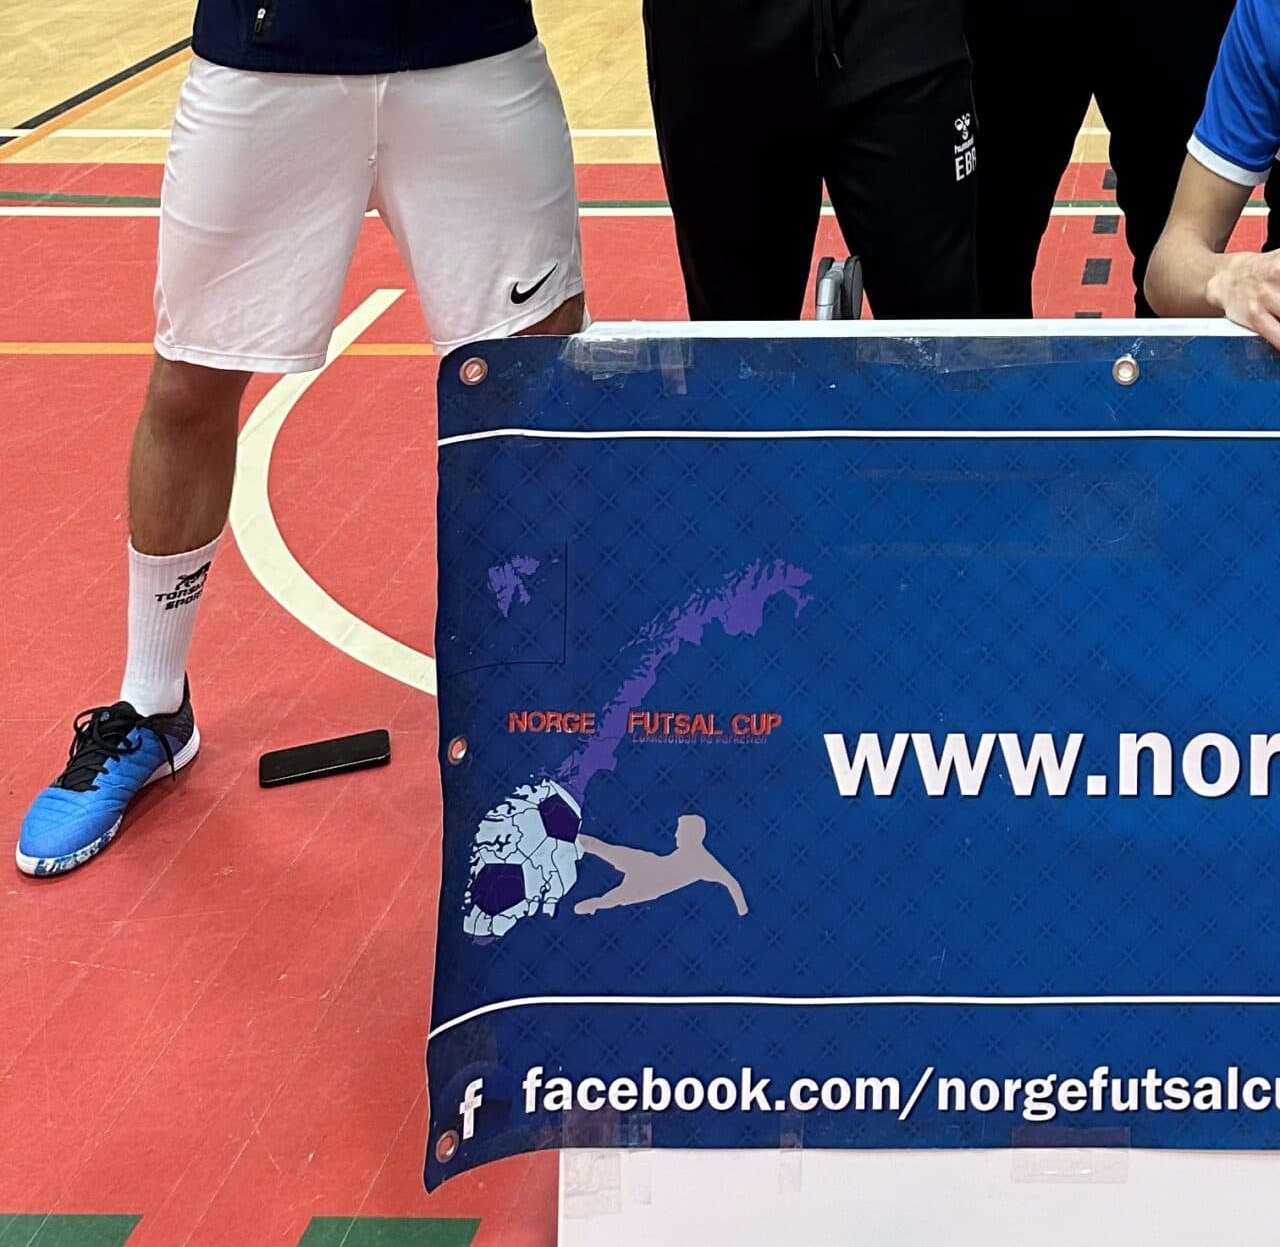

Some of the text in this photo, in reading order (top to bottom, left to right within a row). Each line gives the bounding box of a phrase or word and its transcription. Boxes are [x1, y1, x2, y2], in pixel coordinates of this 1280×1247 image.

[507, 710, 783, 736] NORGE FUTSAL CUP
